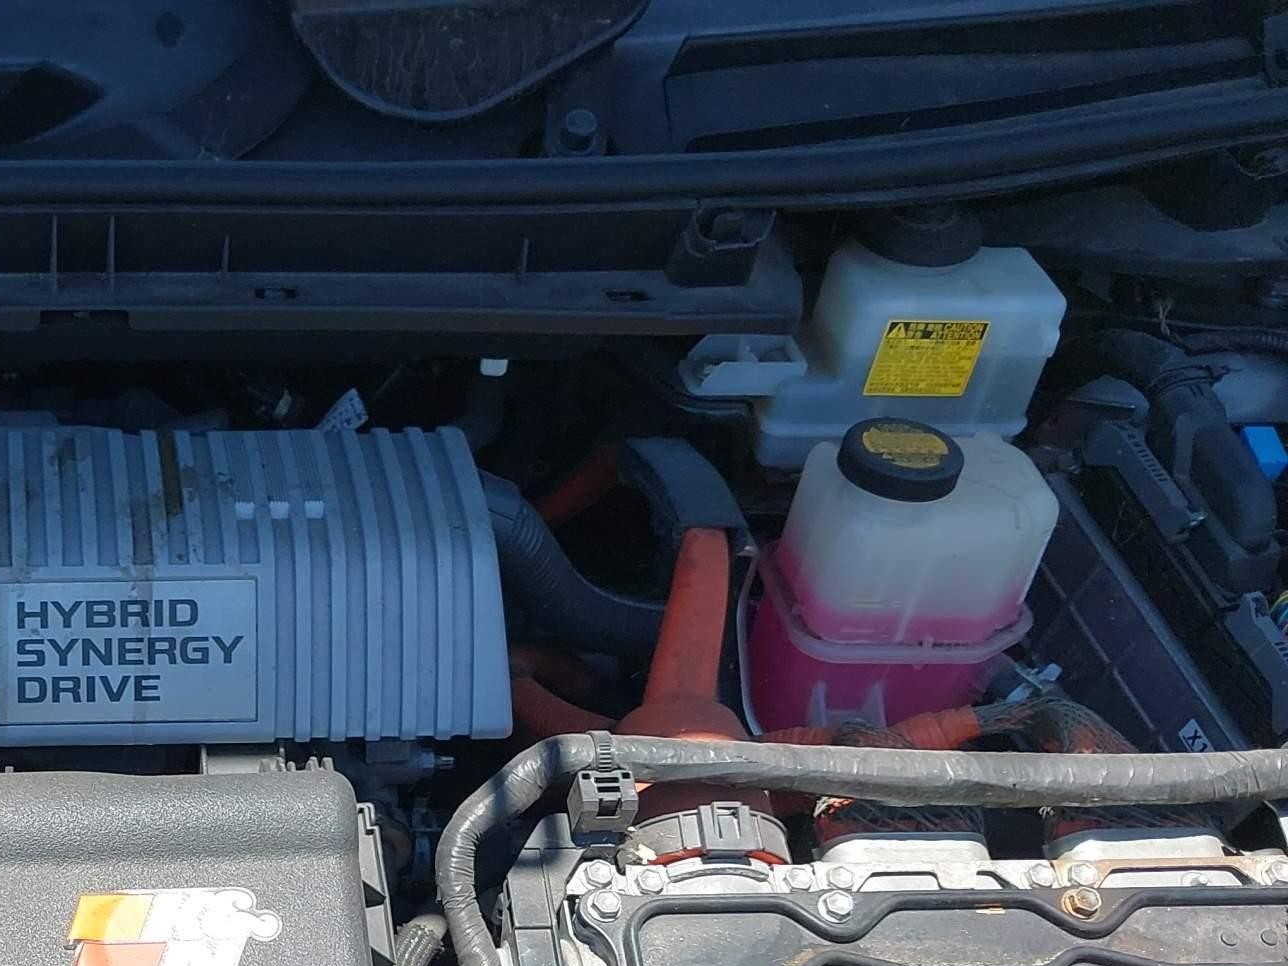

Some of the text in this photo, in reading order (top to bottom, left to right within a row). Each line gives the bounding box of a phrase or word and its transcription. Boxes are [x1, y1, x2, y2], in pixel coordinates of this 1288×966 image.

[17, 599, 199, 629] HYBRID
[17, 635, 245, 667] SYNERGY
[17, 675, 161, 704] DRIVE
